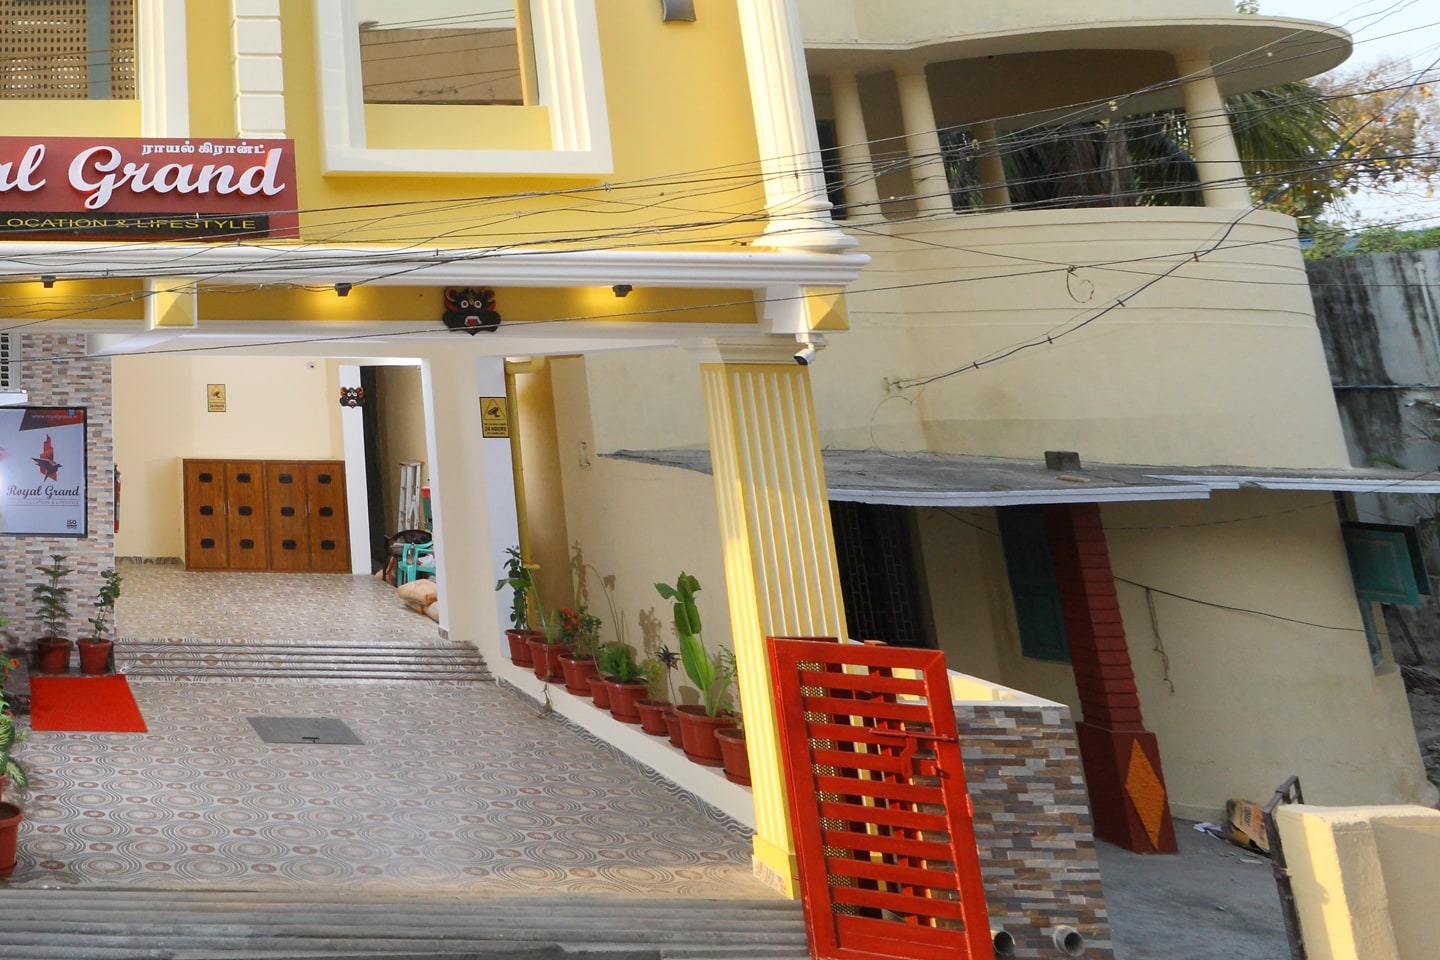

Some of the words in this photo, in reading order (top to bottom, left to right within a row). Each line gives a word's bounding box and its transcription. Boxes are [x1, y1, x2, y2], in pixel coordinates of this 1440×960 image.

[141, 140, 195, 156] ராயல்
[198, 141, 266, 157] கிரான்ட்
[68, 145, 286, 210] Grand
[116, 220, 129, 228] &
[137, 219, 257, 229] LIFESTYLE
[6, 485, 42, 500] Royal
[44, 485, 81, 500] Grand
